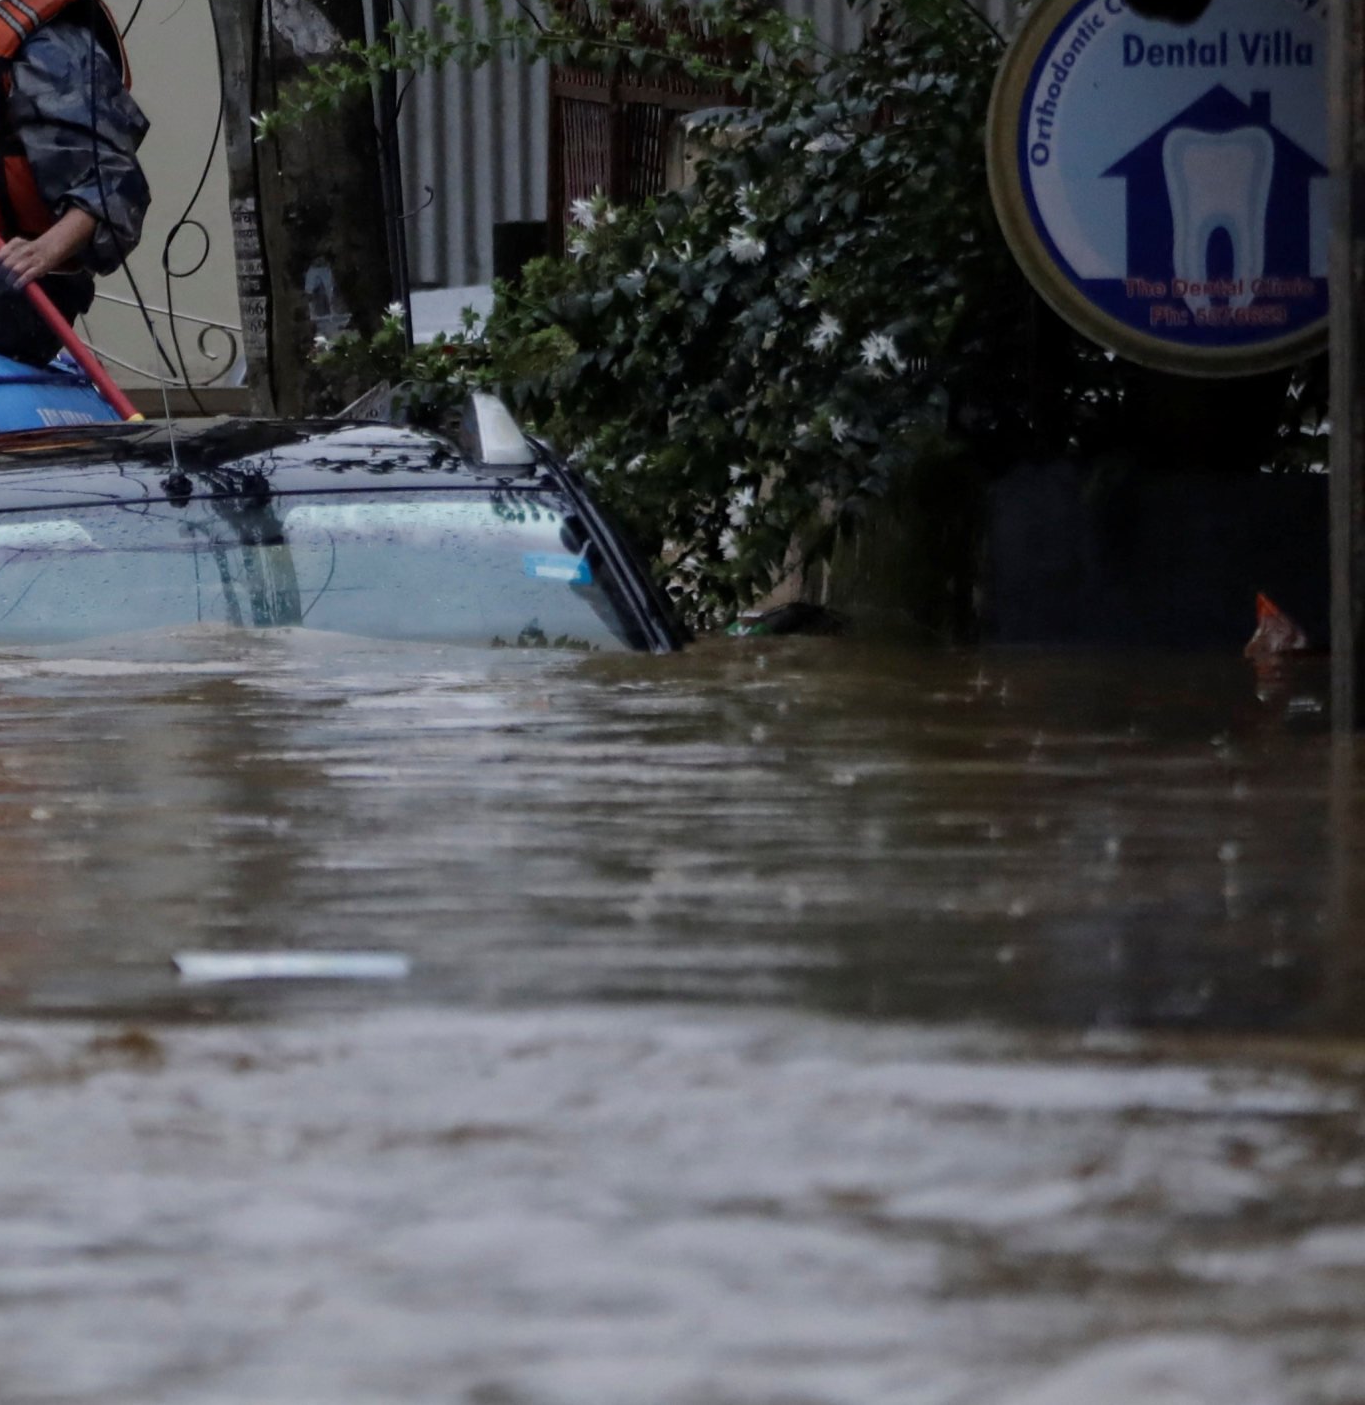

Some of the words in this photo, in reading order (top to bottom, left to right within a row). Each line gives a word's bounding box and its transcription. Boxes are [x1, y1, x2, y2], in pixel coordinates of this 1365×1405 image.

[1122, 32, 1227, 68] Dental
[1238, 30, 1314, 68] Villa
[1030, 13, 1106, 167] Orthodontic
[1125, 278, 1167, 299] The
[1171, 278, 1243, 299] Dental
[1149, 306, 1189, 328] Ph:
